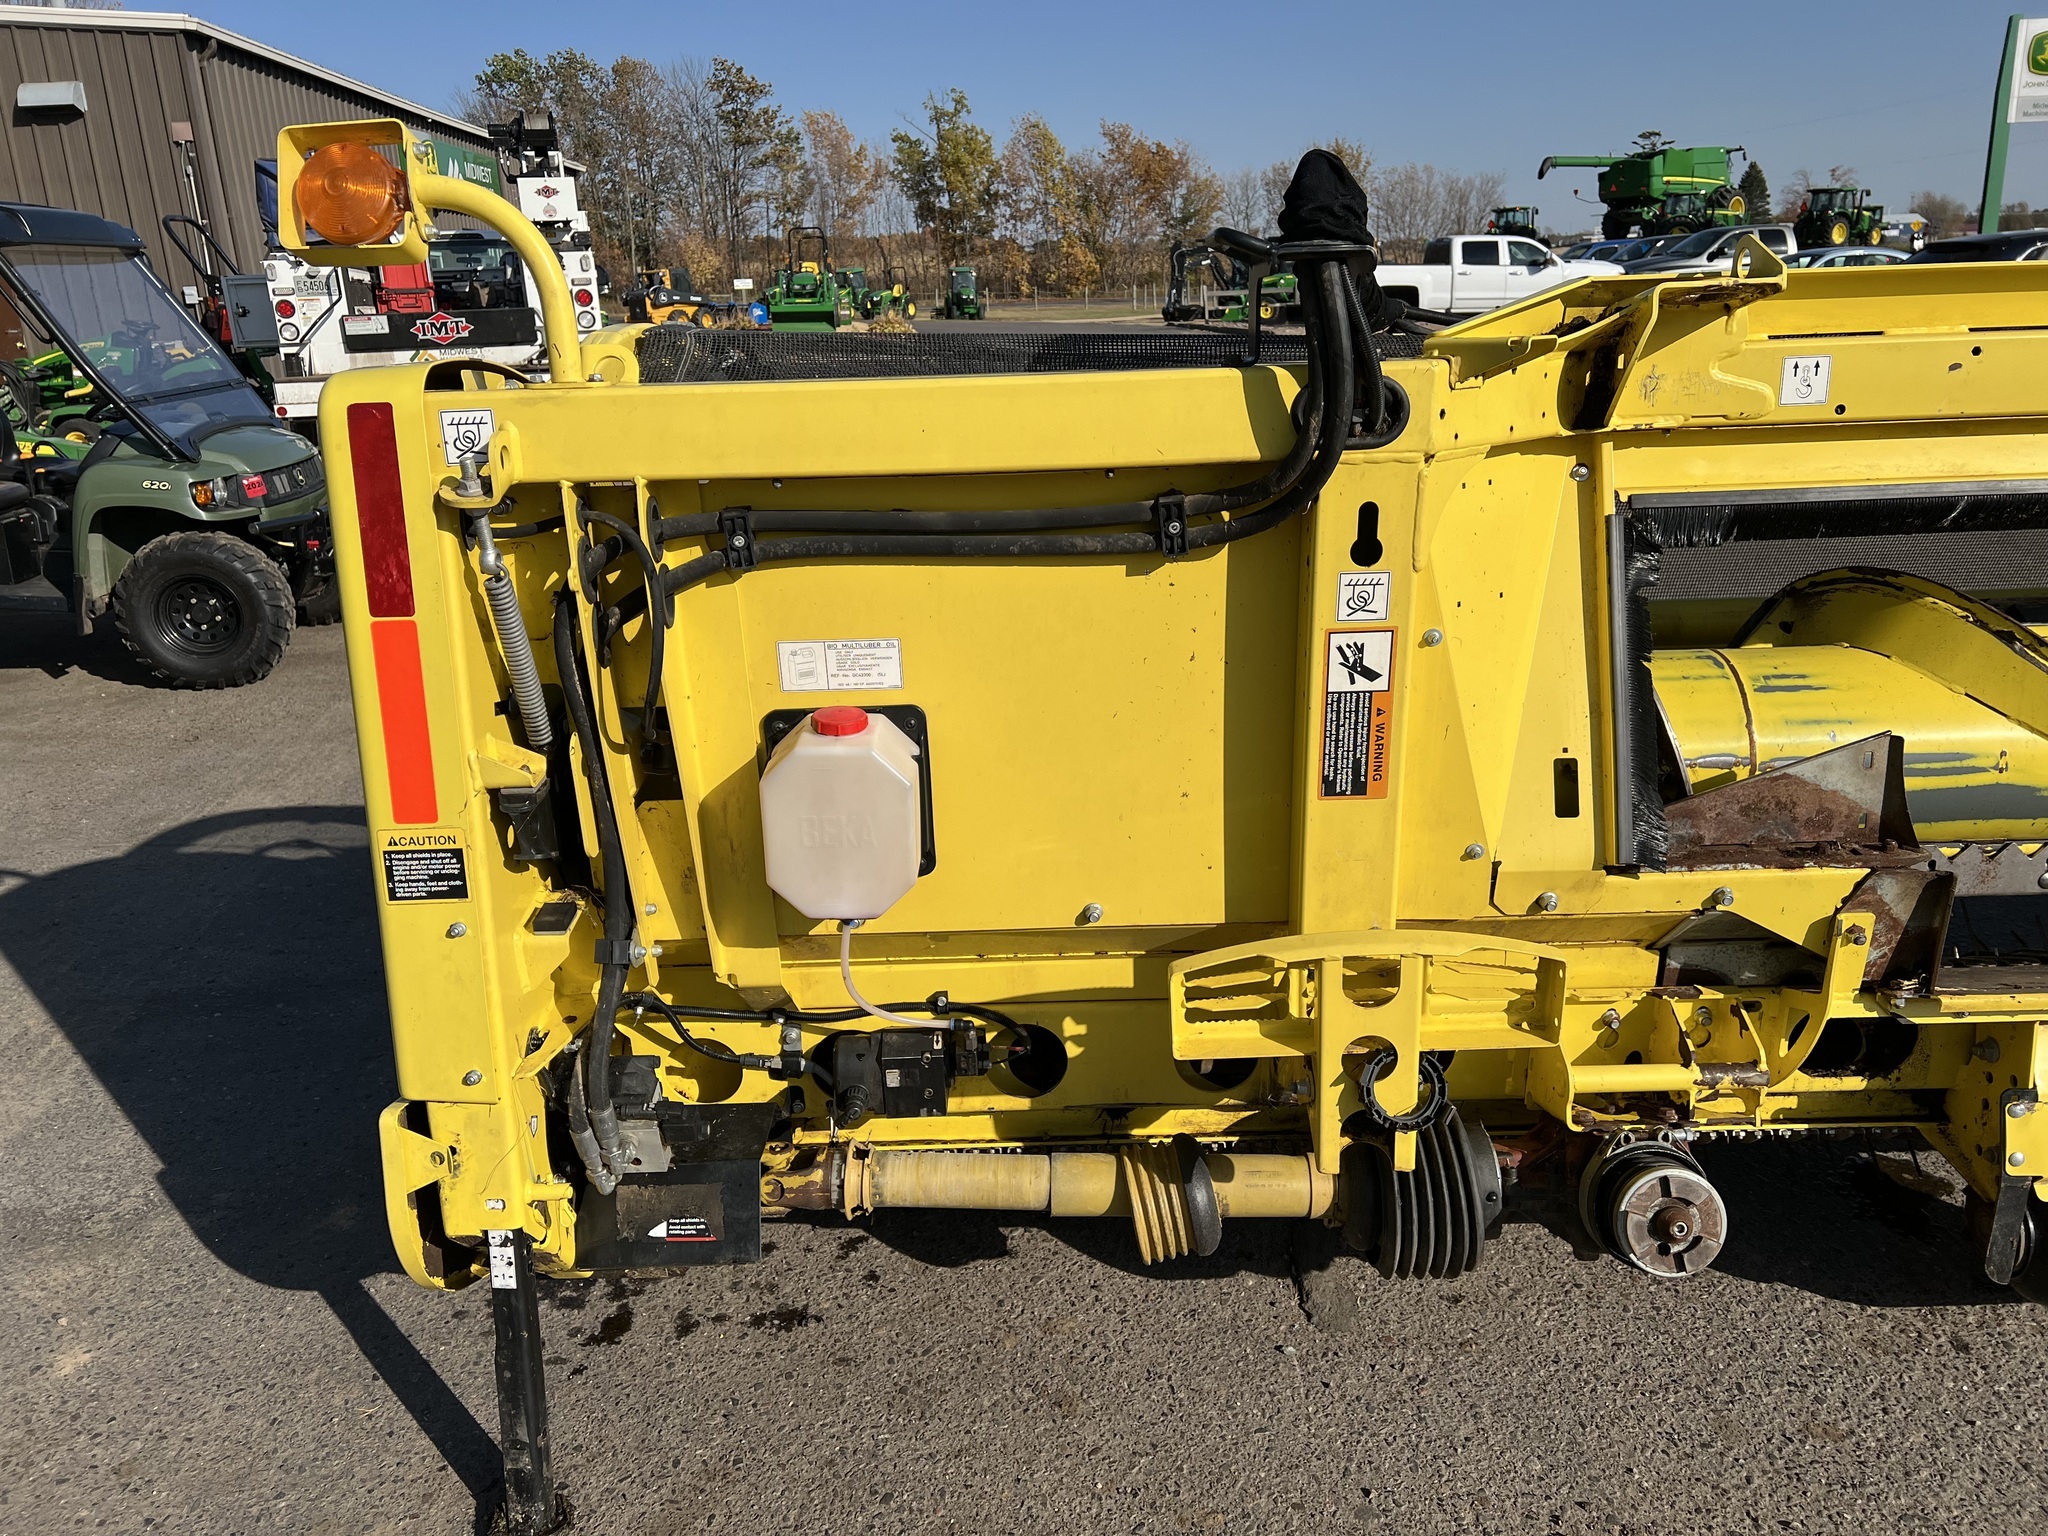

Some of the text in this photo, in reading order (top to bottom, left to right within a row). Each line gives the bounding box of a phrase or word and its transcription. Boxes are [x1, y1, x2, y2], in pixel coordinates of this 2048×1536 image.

[2023, 80, 2045, 88] JOHN
[464, 161, 492, 184] MIDWEST
[419, 321, 464, 337] IMT
[440, 348, 483, 356] MIDWEST
[1373, 723, 1385, 782] WARNING
[800, 815, 877, 848] BEKA
[399, 836, 457, 847] CAUTION
